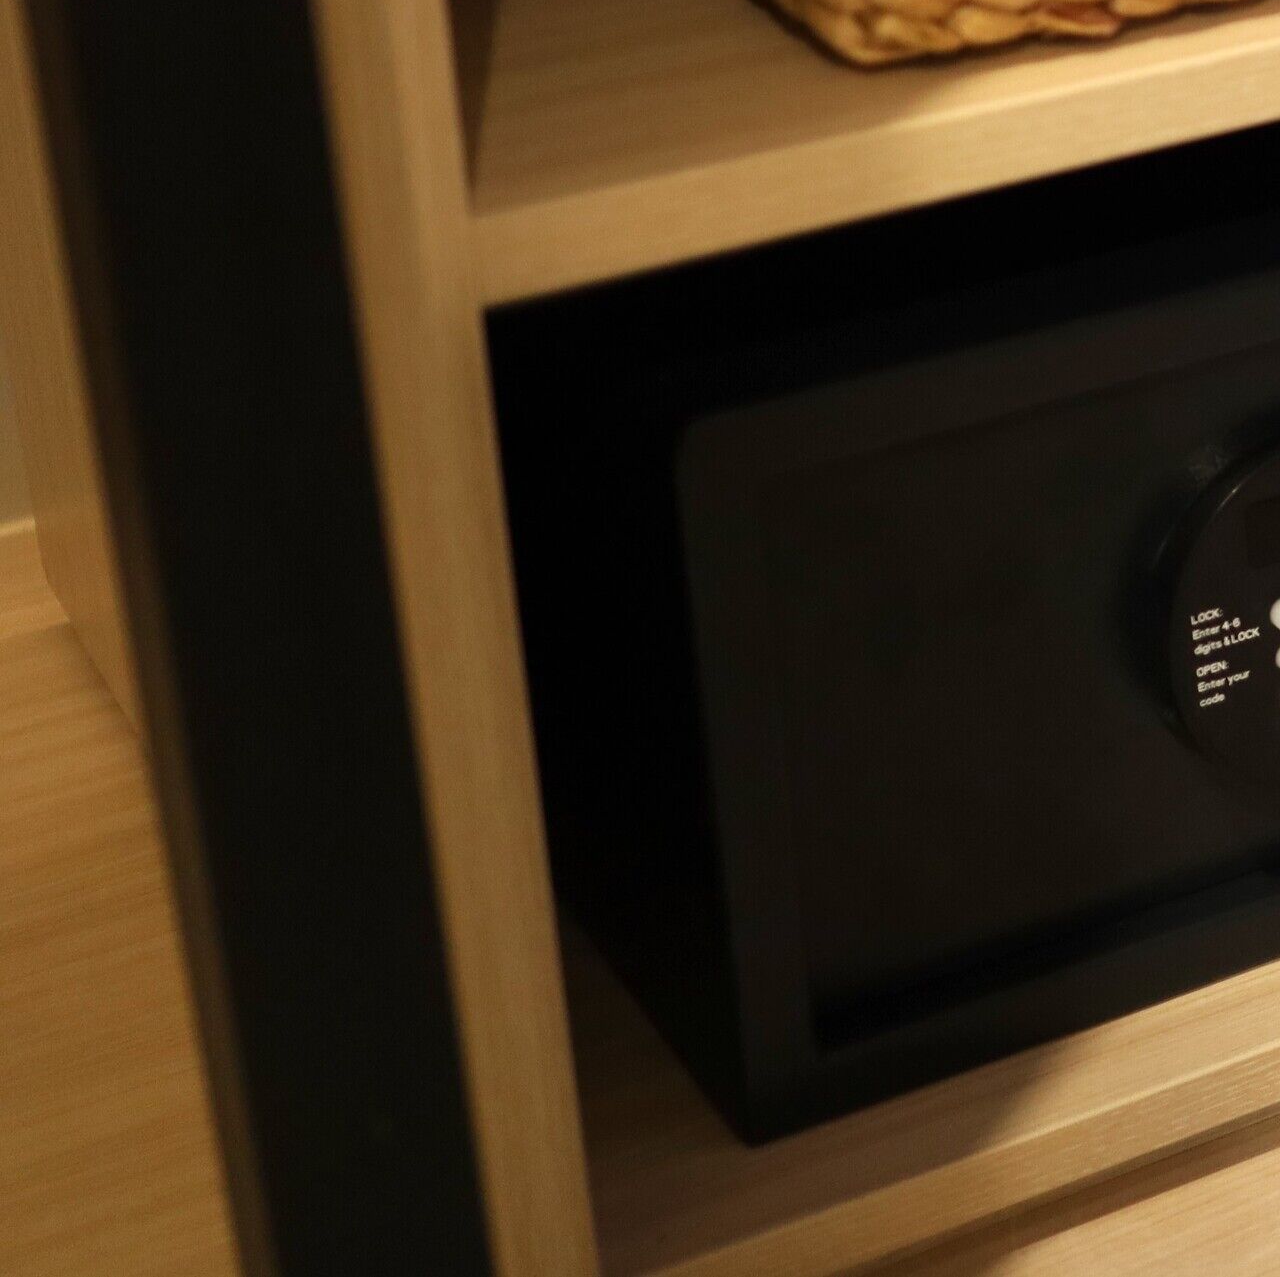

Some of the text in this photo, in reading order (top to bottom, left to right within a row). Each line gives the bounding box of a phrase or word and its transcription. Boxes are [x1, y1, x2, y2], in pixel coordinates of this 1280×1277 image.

[1192, 624, 1221, 640] Enter
[1194, 639, 1222, 656] digits
[1231, 627, 1260, 643] LOCK
[1197, 670, 1250, 692] Enter your
[1199, 692, 1225, 707] code
